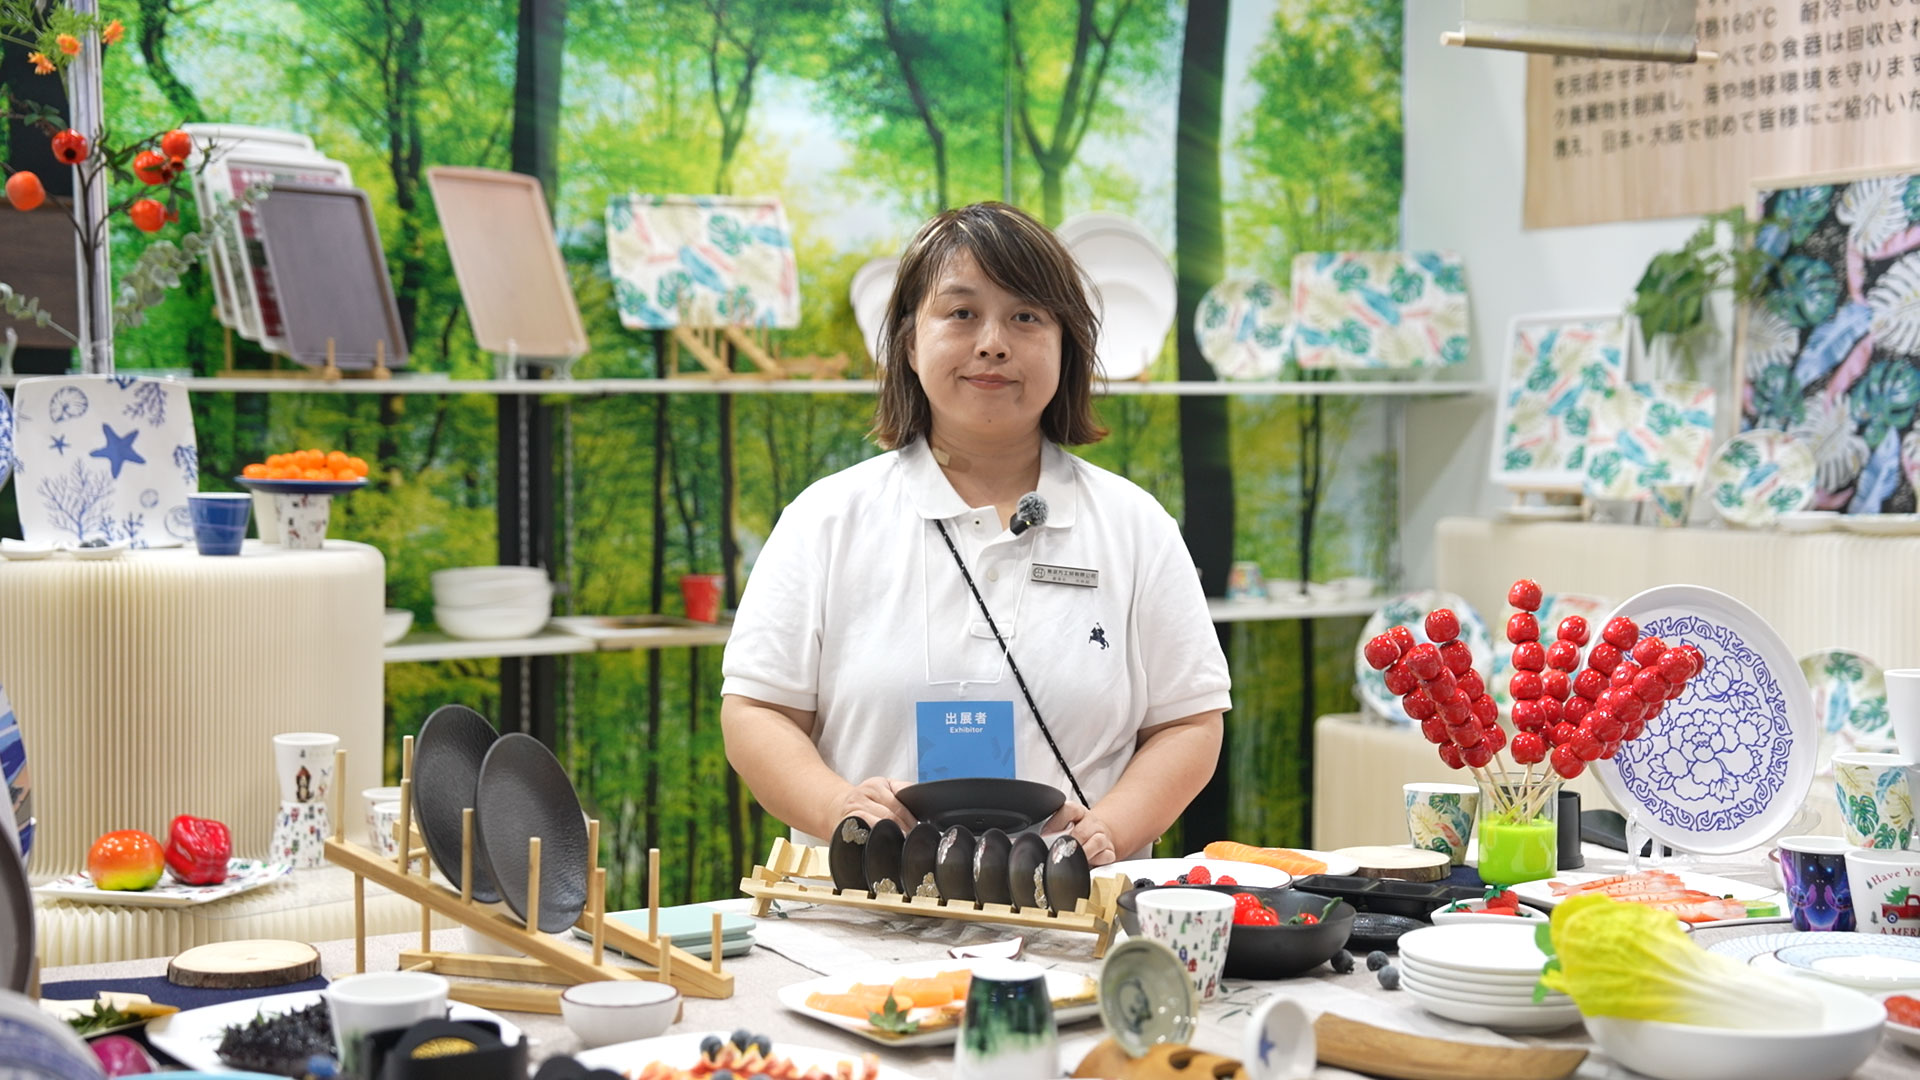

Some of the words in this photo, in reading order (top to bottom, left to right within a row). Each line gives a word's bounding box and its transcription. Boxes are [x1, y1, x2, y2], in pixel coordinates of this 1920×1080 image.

[945, 712, 987, 725] 出展者
[949, 726, 984, 734] Exhibitor
[1871, 872, 1900, 885] Have
[1880, 926, 1887, 935] A
[1891, 927, 1920, 937] MER
